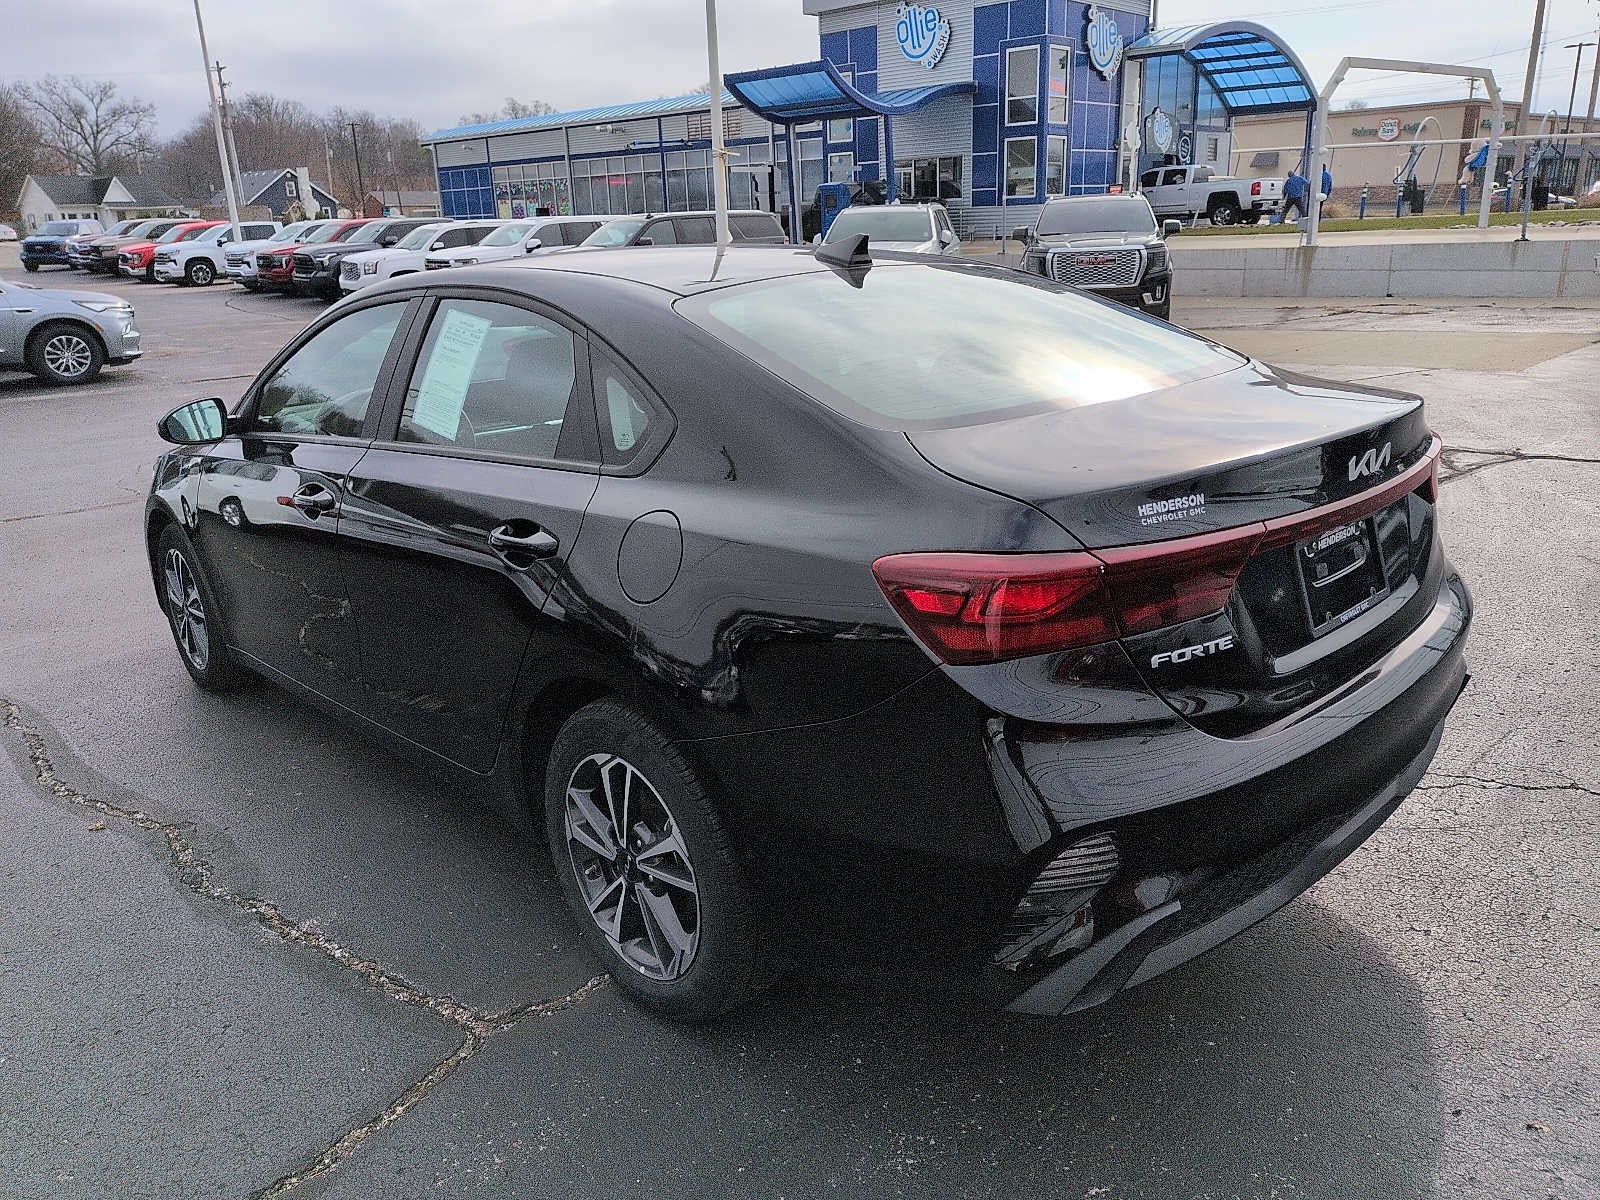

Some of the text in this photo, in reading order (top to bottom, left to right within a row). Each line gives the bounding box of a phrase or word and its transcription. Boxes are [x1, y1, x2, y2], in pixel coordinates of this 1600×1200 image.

[896, 8, 937, 50] ollie
[1091, 14, 1117, 57] ollie
[931, 35, 948, 61] WASH
[1348, 441, 1392, 482] KIA
[1137, 492, 1205, 517] HENDERSON
[1141, 506, 1206, 526] CHEVROLET GMC
[1318, 524, 1356, 551] HENDERSON
[1150, 635, 1234, 669] FORTE
